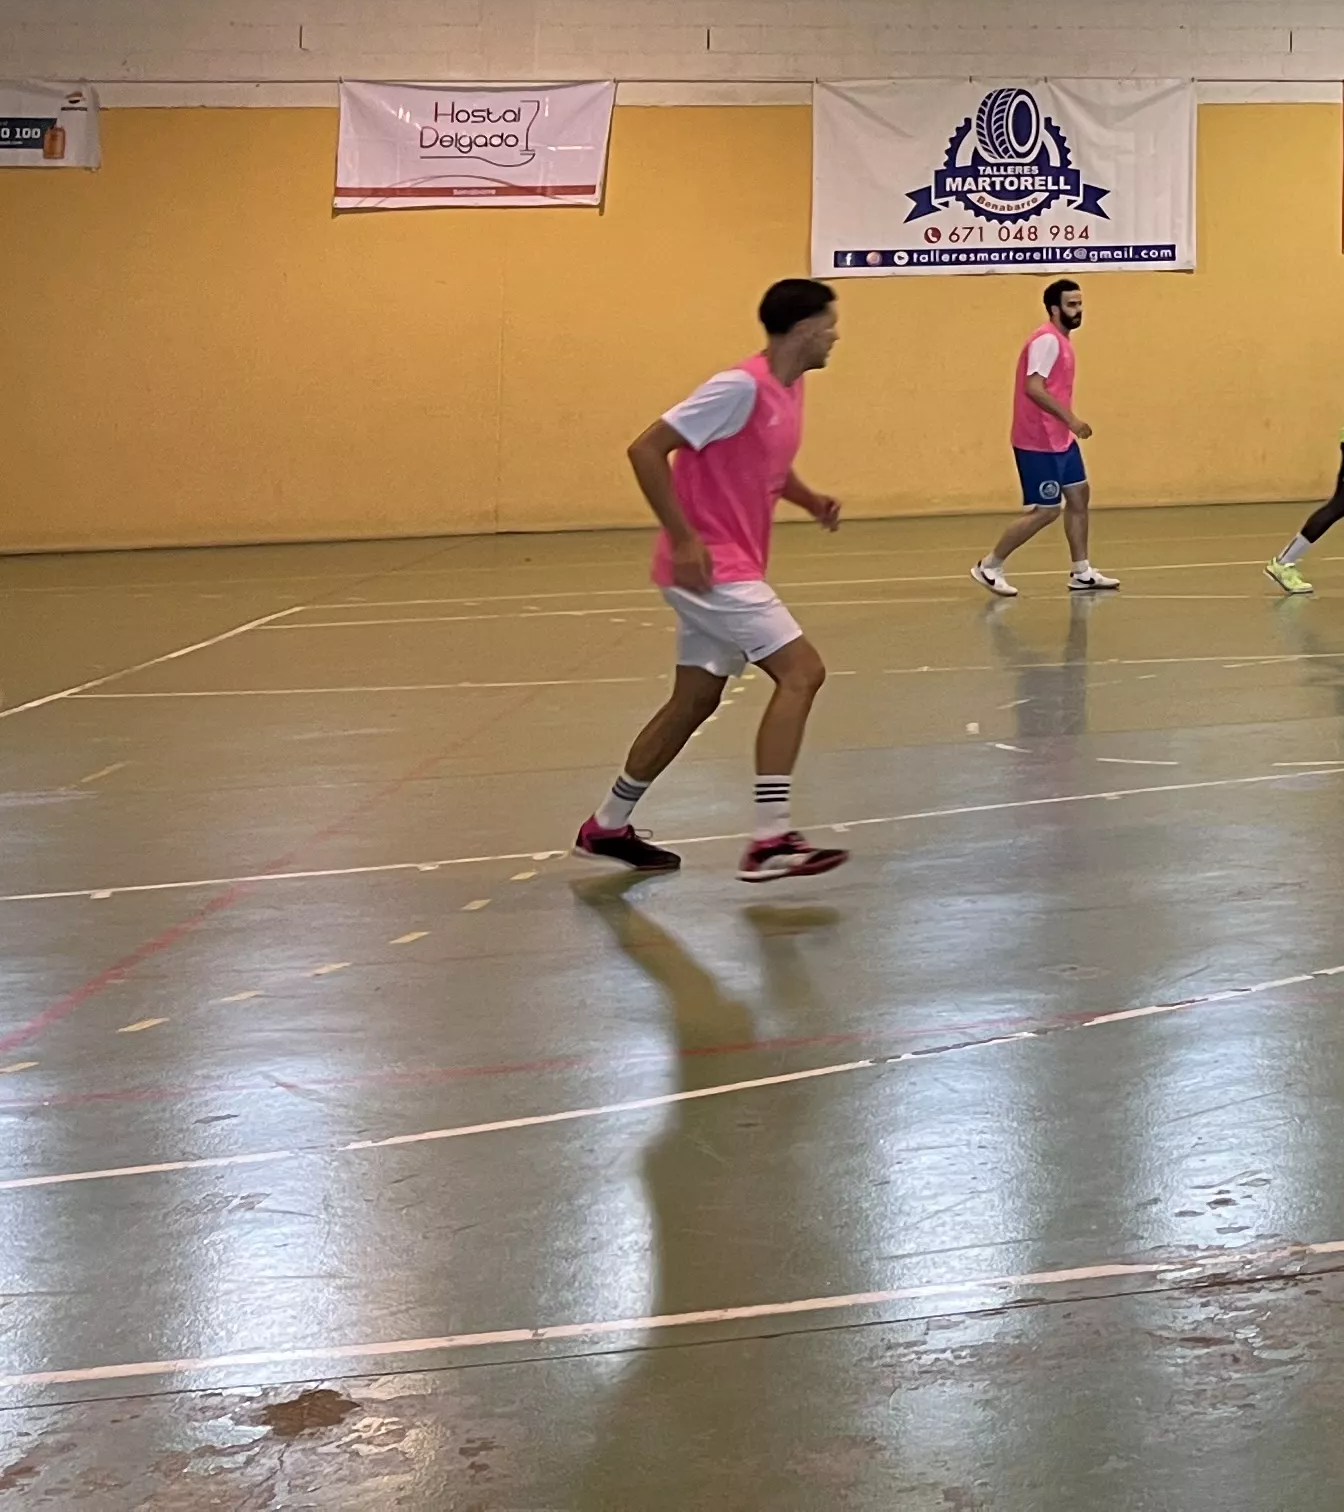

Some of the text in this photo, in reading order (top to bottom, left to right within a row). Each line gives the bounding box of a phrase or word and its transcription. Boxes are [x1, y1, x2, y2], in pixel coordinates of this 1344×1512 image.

[433, 100, 521, 124] Hostal
[15, 128, 41, 139] 100
[419, 126, 520, 155] Delgado
[977, 165, 1039, 176] TALLERES
[945, 175, 1072, 191] MARTORELL
[948, 224, 1090, 243] 671 048 984
[912, 246, 1173, 263] talleresmartorell16@gmail.com
